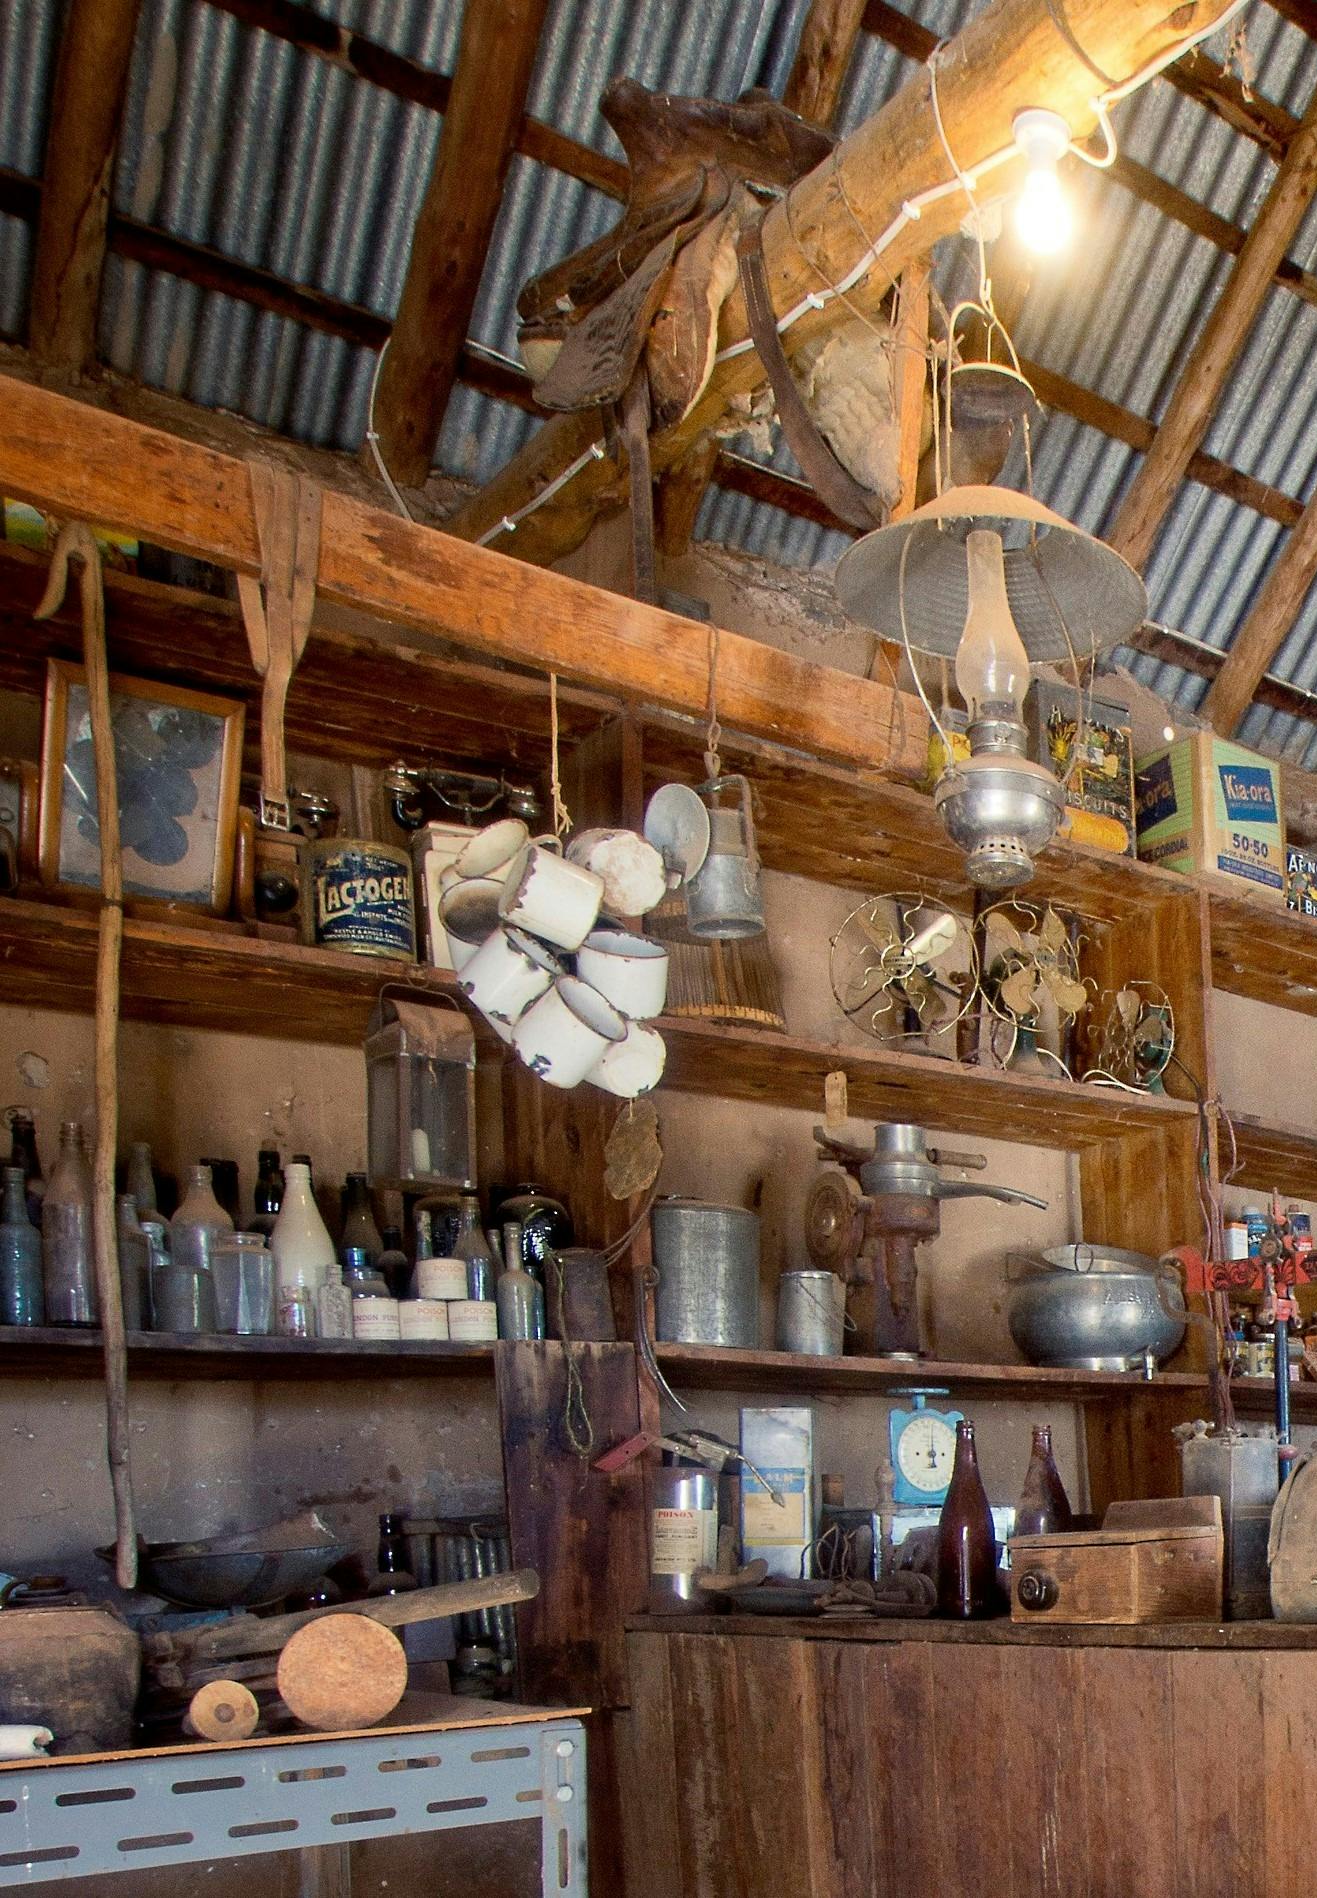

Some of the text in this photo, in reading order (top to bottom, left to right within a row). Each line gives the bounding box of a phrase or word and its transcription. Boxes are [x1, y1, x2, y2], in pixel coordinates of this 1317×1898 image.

[1067, 791, 1128, 819] ISCUITS
[353, 1314, 379, 1323] ONDON
[657, 1511, 694, 1519] POISON
